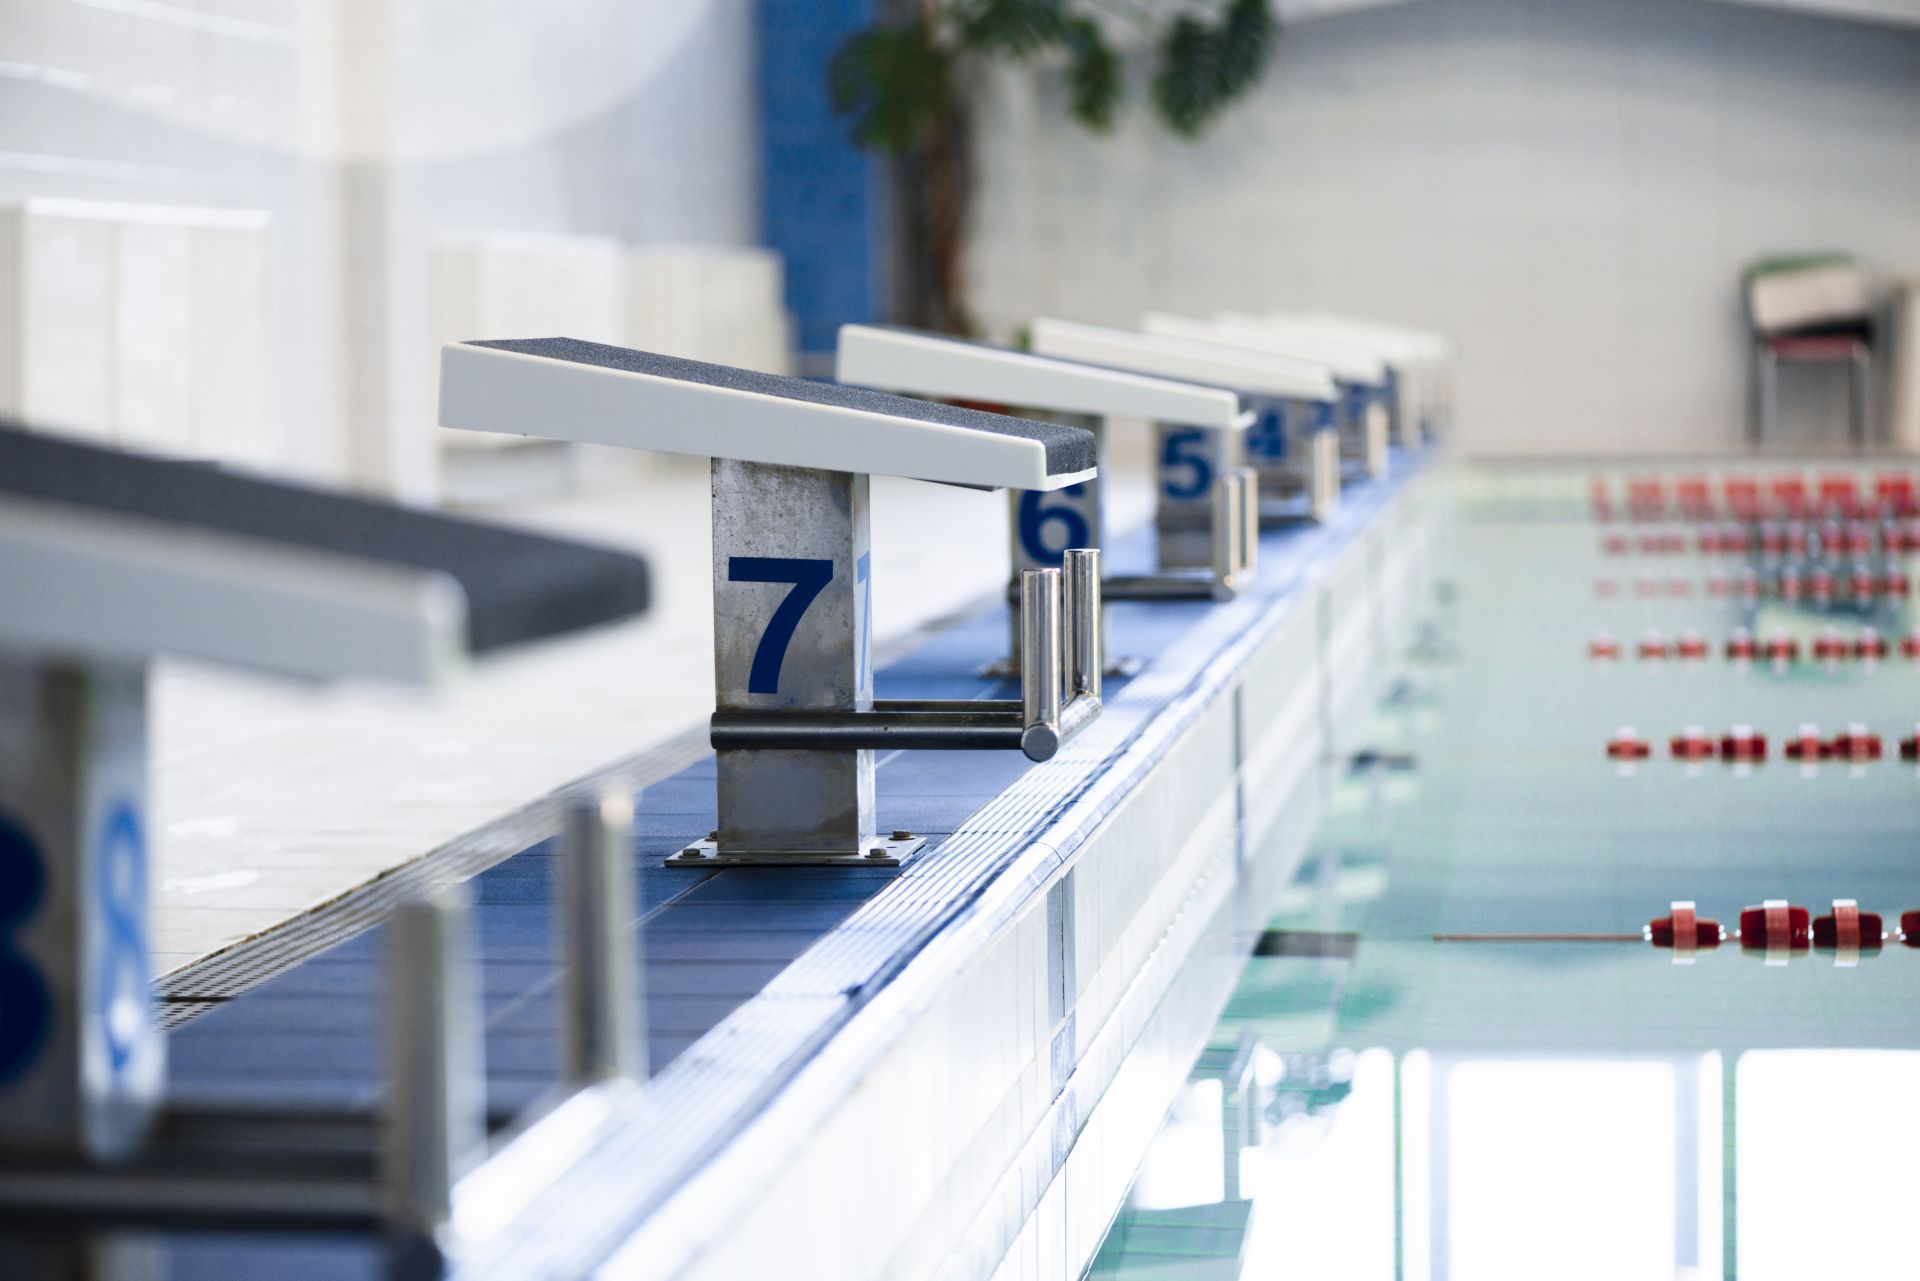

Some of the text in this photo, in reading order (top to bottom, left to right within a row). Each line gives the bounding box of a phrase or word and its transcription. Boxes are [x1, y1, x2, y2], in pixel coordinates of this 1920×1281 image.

[1164, 431, 1211, 499] 5
[1018, 482, 1088, 565] 6
[728, 556, 834, 695] 7
